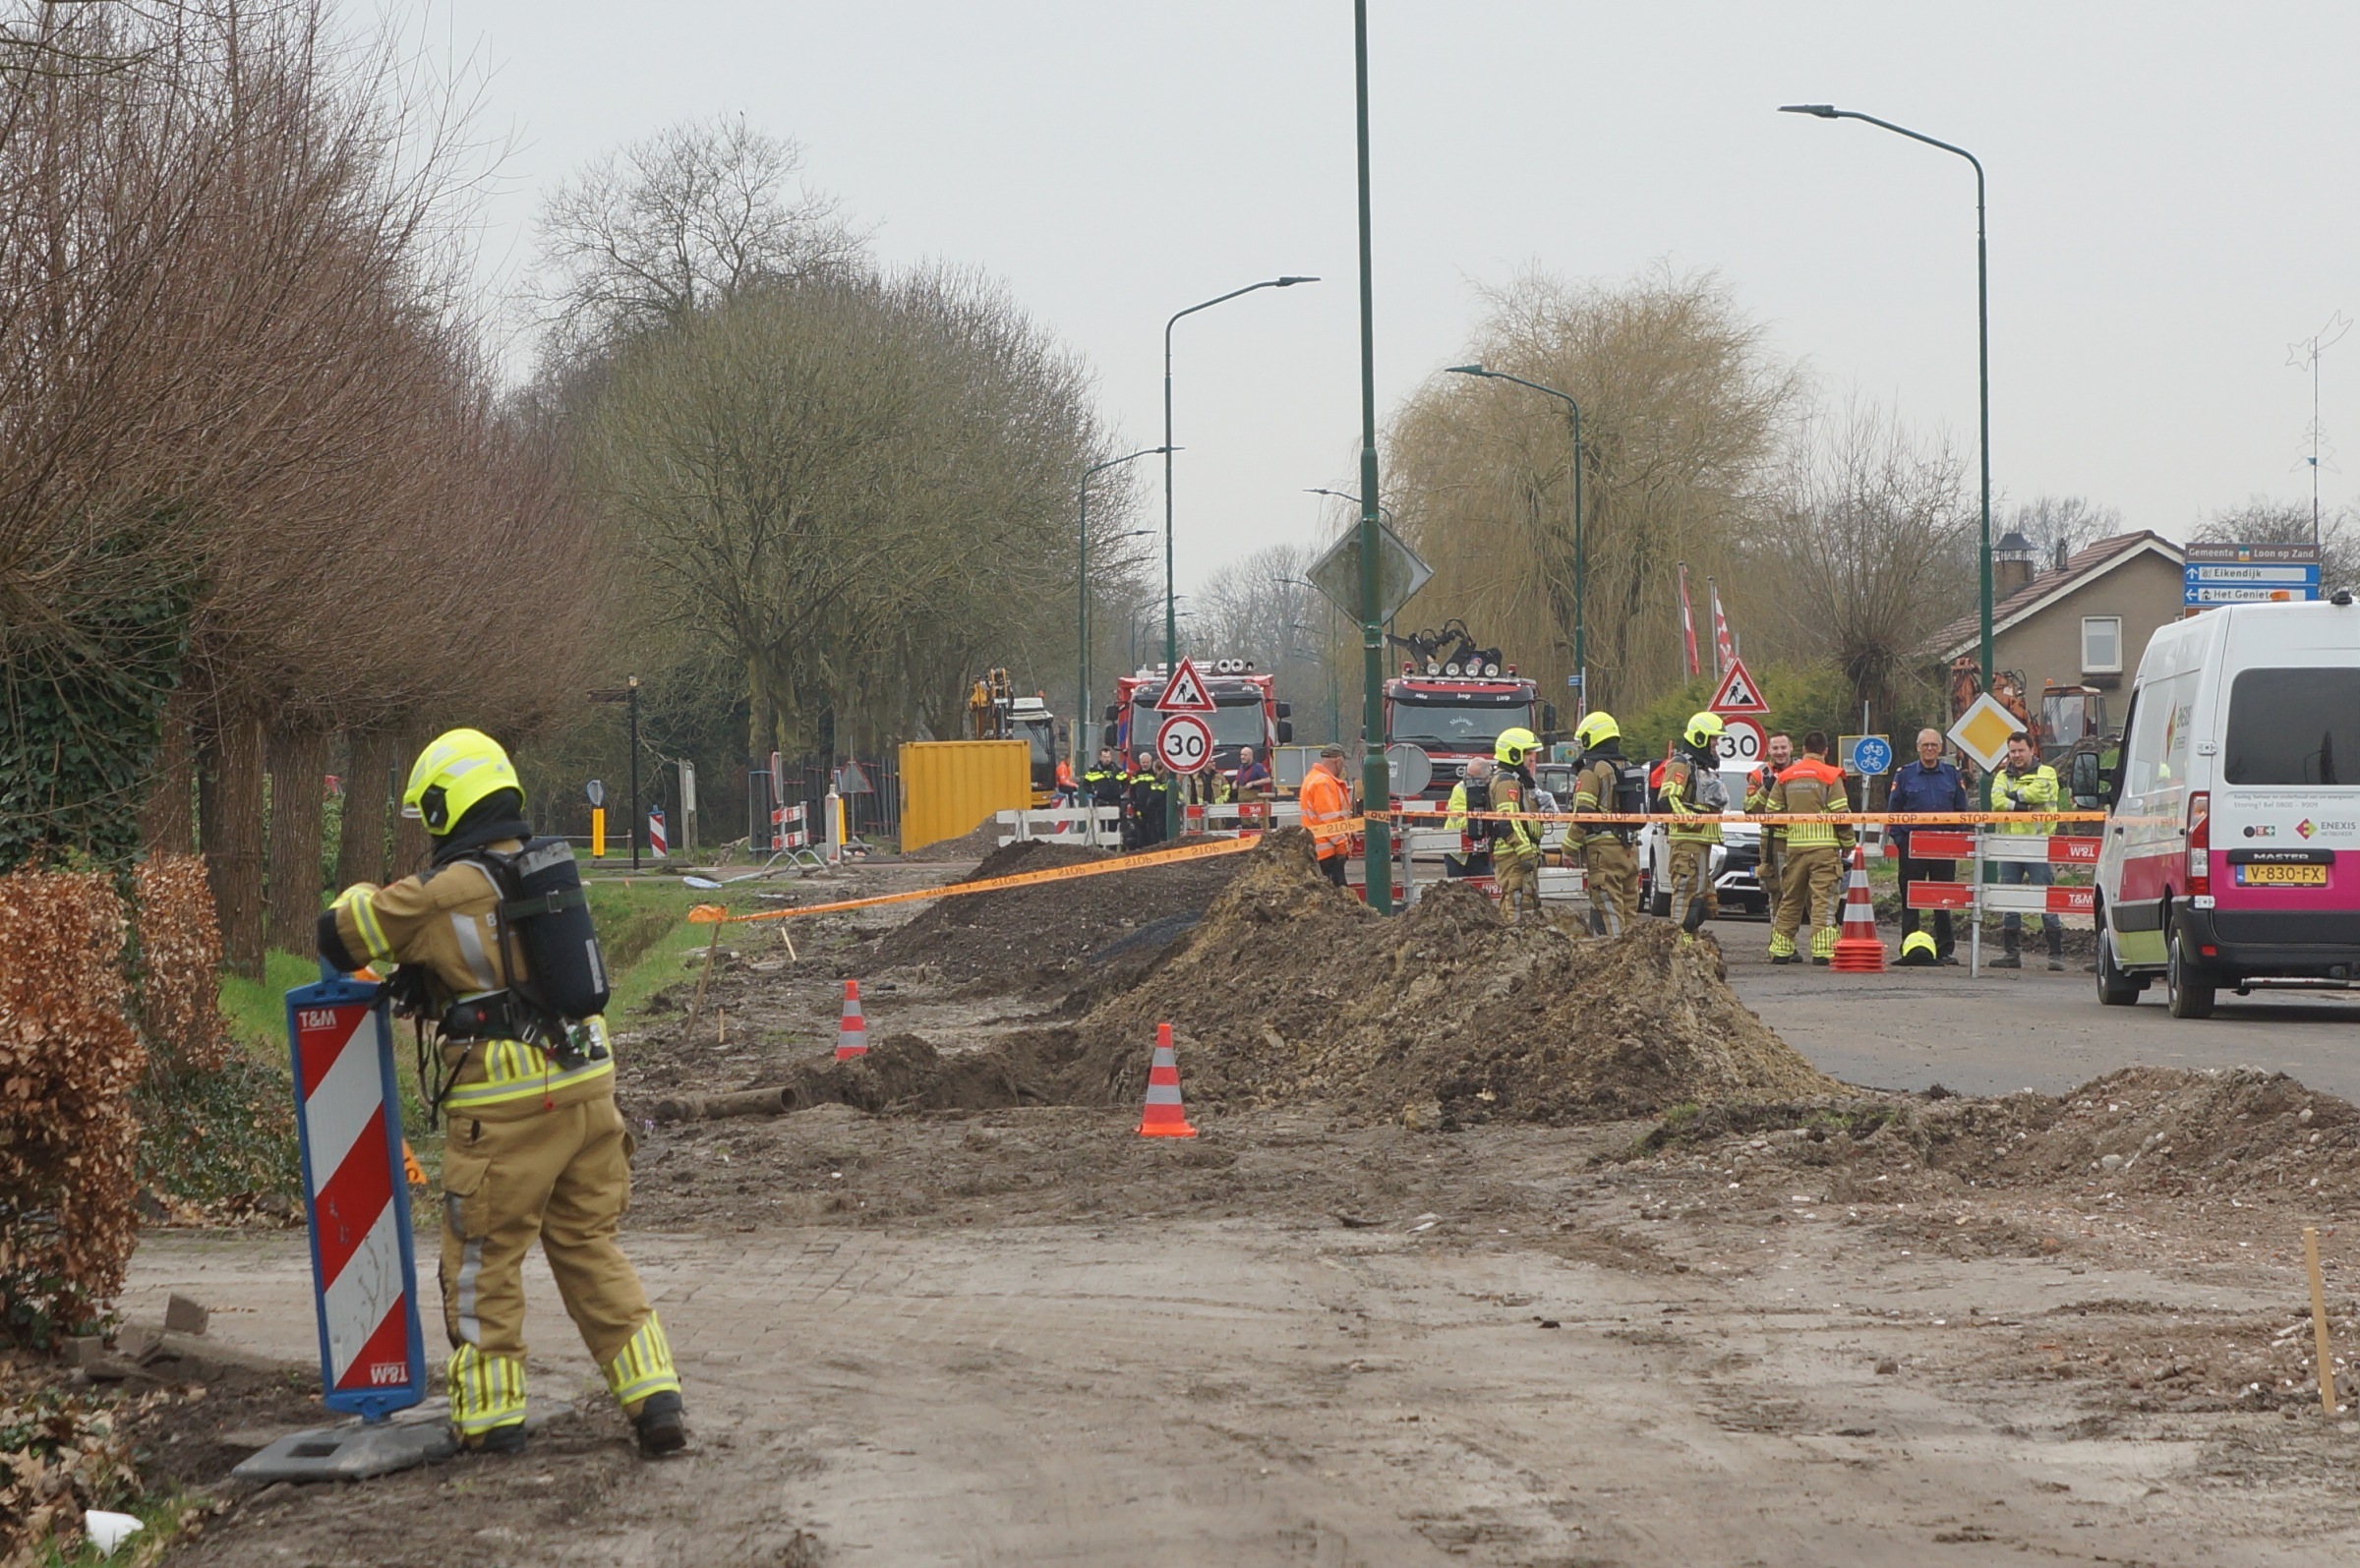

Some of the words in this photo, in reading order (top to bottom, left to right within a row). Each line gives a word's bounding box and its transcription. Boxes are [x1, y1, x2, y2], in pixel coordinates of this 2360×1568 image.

[2188, 548, 2234, 557] Gemeente
[2254, 549, 2275, 557] Loon
[2278, 551, 2289, 559] op
[2291, 549, 2314, 558] Zand
[2214, 568, 2262, 580] Eikendijk
[2235, 590, 2272, 599] Geniet
[1166, 734, 1204, 757] 30
[1720, 735, 1757, 758] 30
[1816, 814, 1846, 823] STOP
[1888, 814, 1918, 823] STOP
[1960, 814, 1989, 823] STOP
[2070, 846, 2095, 857] T&M
[2250, 866, 2321, 881] V-830-FX
[2068, 894, 2094, 904] T&M
[299, 1009, 337, 1028] T&M
[370, 1365, 409, 1384] T&M
